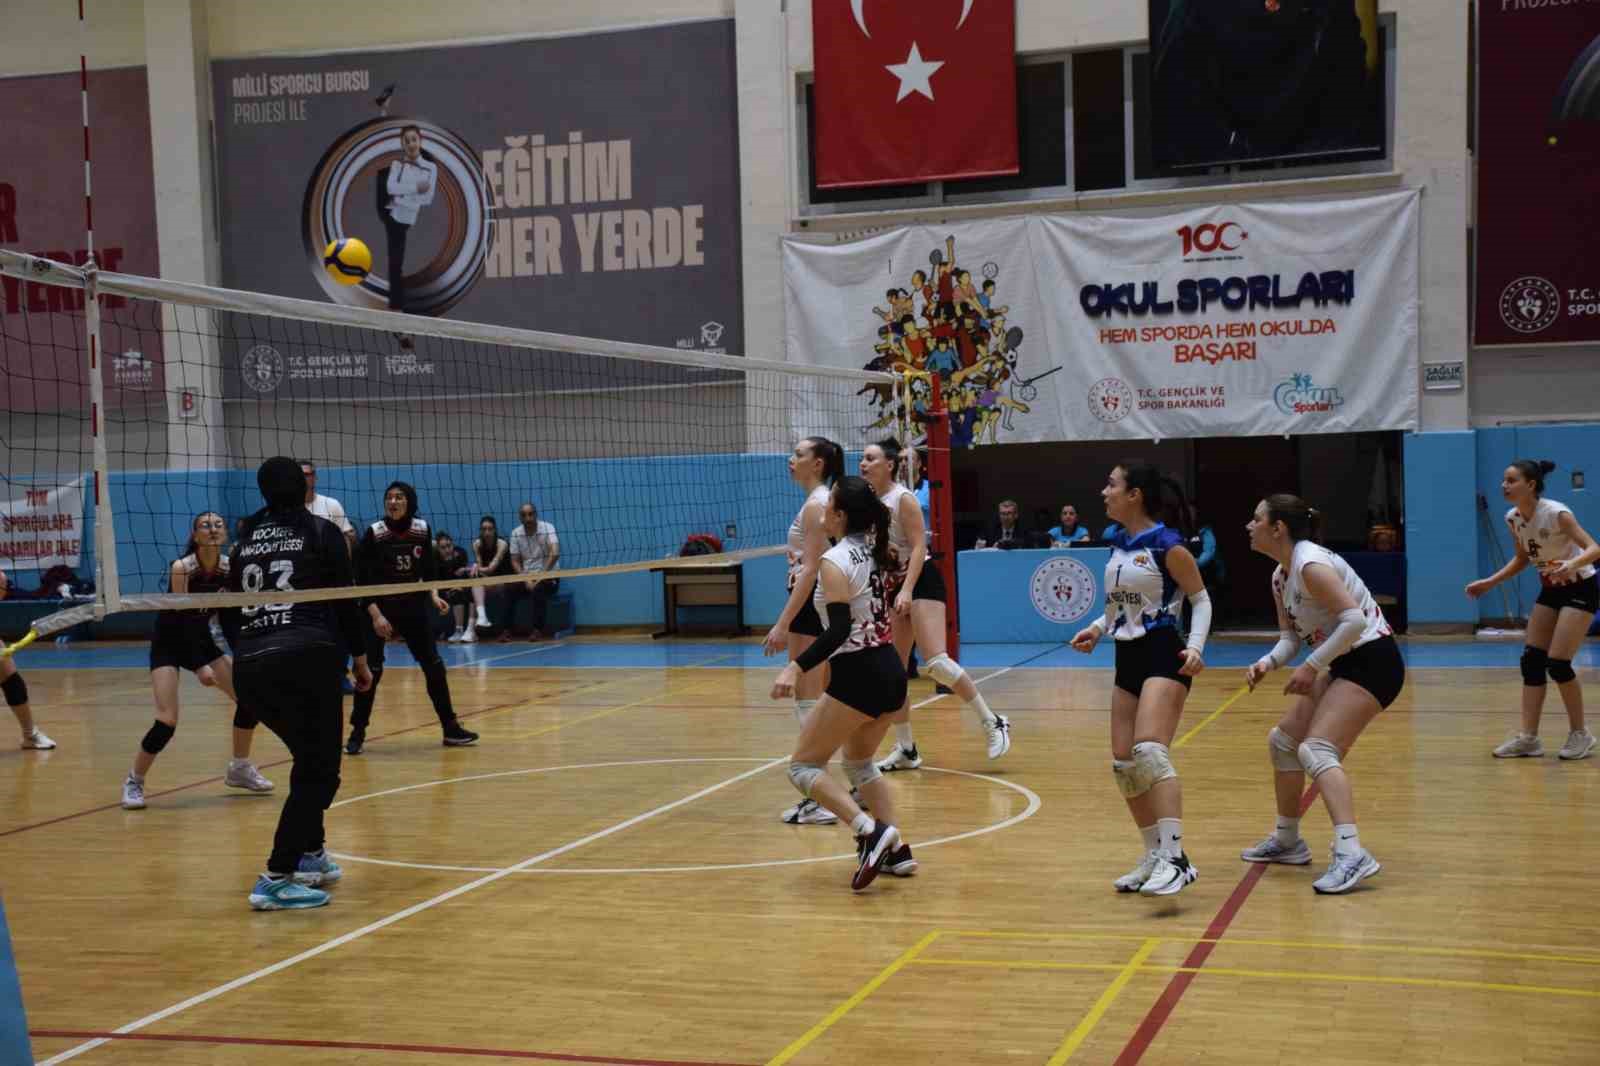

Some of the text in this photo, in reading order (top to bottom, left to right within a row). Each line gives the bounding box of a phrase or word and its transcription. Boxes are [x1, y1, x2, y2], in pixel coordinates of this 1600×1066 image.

[269, 73, 323, 96] SPORCU
[325, 70, 369, 92] BURSU
[482, 131, 632, 209] EĞİTİM
[485, 204, 704, 278] HER YERDE
[1080, 270, 1355, 319] OKUL SPORLARI
[1568, 288, 1595, 299] T.C.
[1567, 304, 1600, 315] SPO
[1099, 319, 1336, 344] HEM SPORDA HEM OKULDA
[1174, 343, 1257, 365] BAŞARI
[1138, 397, 1226, 410] SPOR BAKANLIĞI
[1158, 386, 1207, 398] GENÇLİK
[1210, 386, 1225, 395] VE
[1114, 564, 1123, 588] 1
